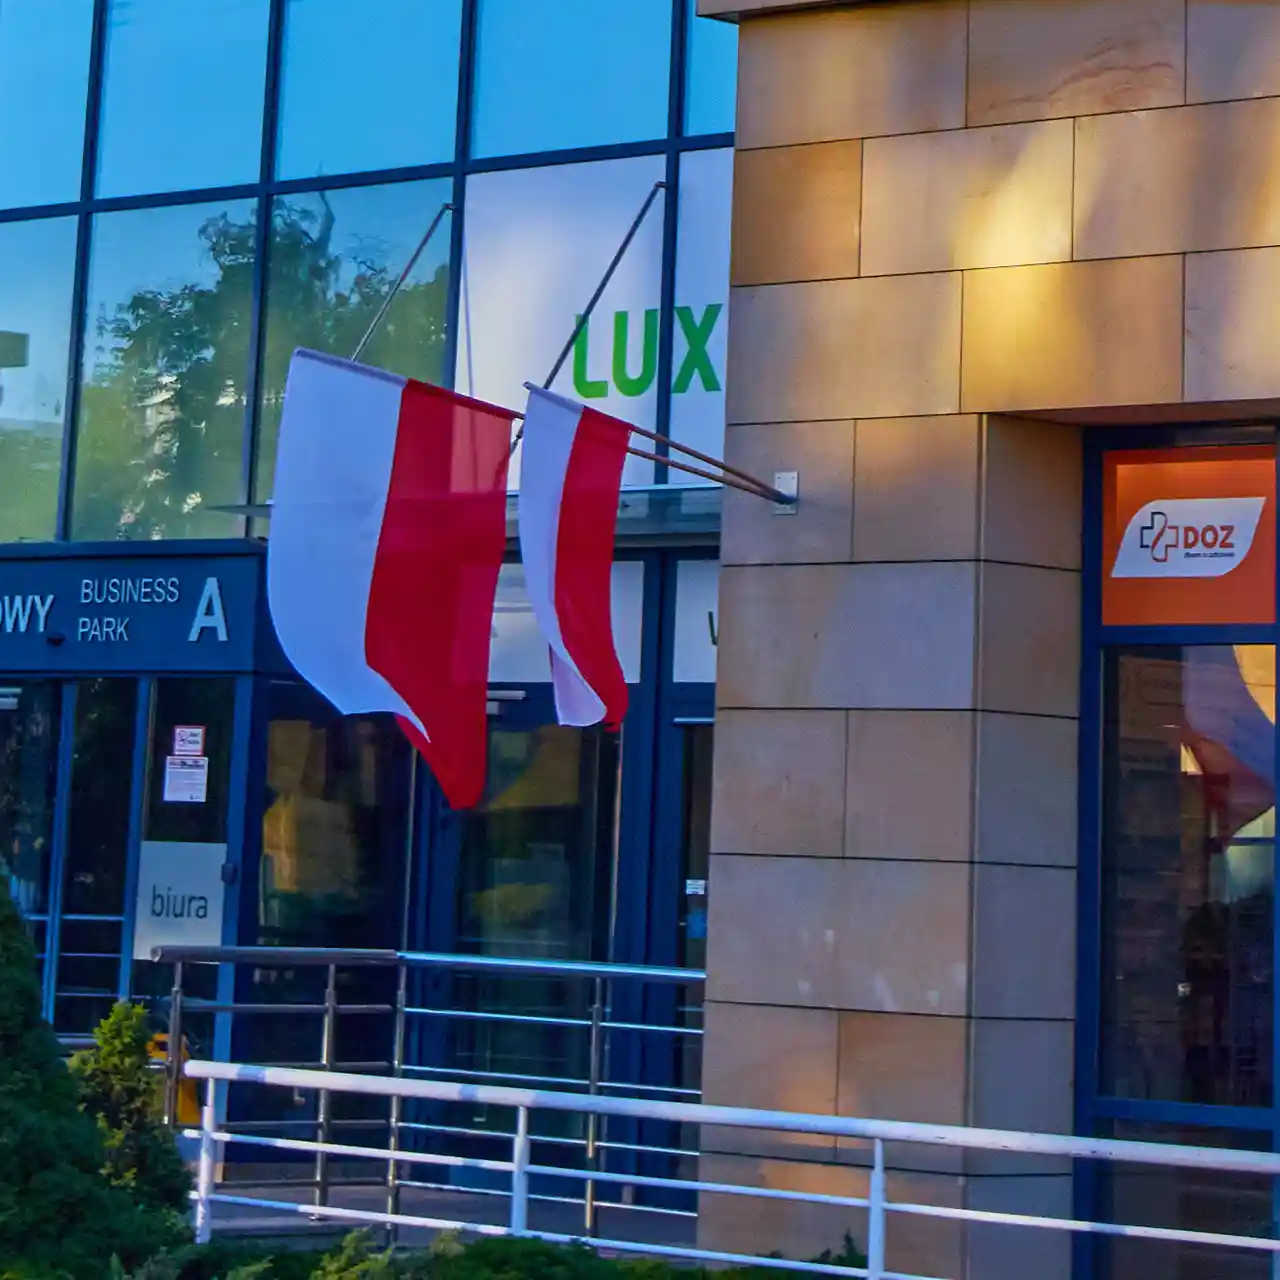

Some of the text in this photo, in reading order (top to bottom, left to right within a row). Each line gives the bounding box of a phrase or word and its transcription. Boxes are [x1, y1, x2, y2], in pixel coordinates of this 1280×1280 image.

[573, 303, 724, 399] LUX
[1183, 525, 1235, 549] DOZ
[80, 578, 180, 604] BUSINESS
[188, 576, 229, 642] A
[77, 617, 130, 642] PARK
[150, 884, 208, 919] biura
